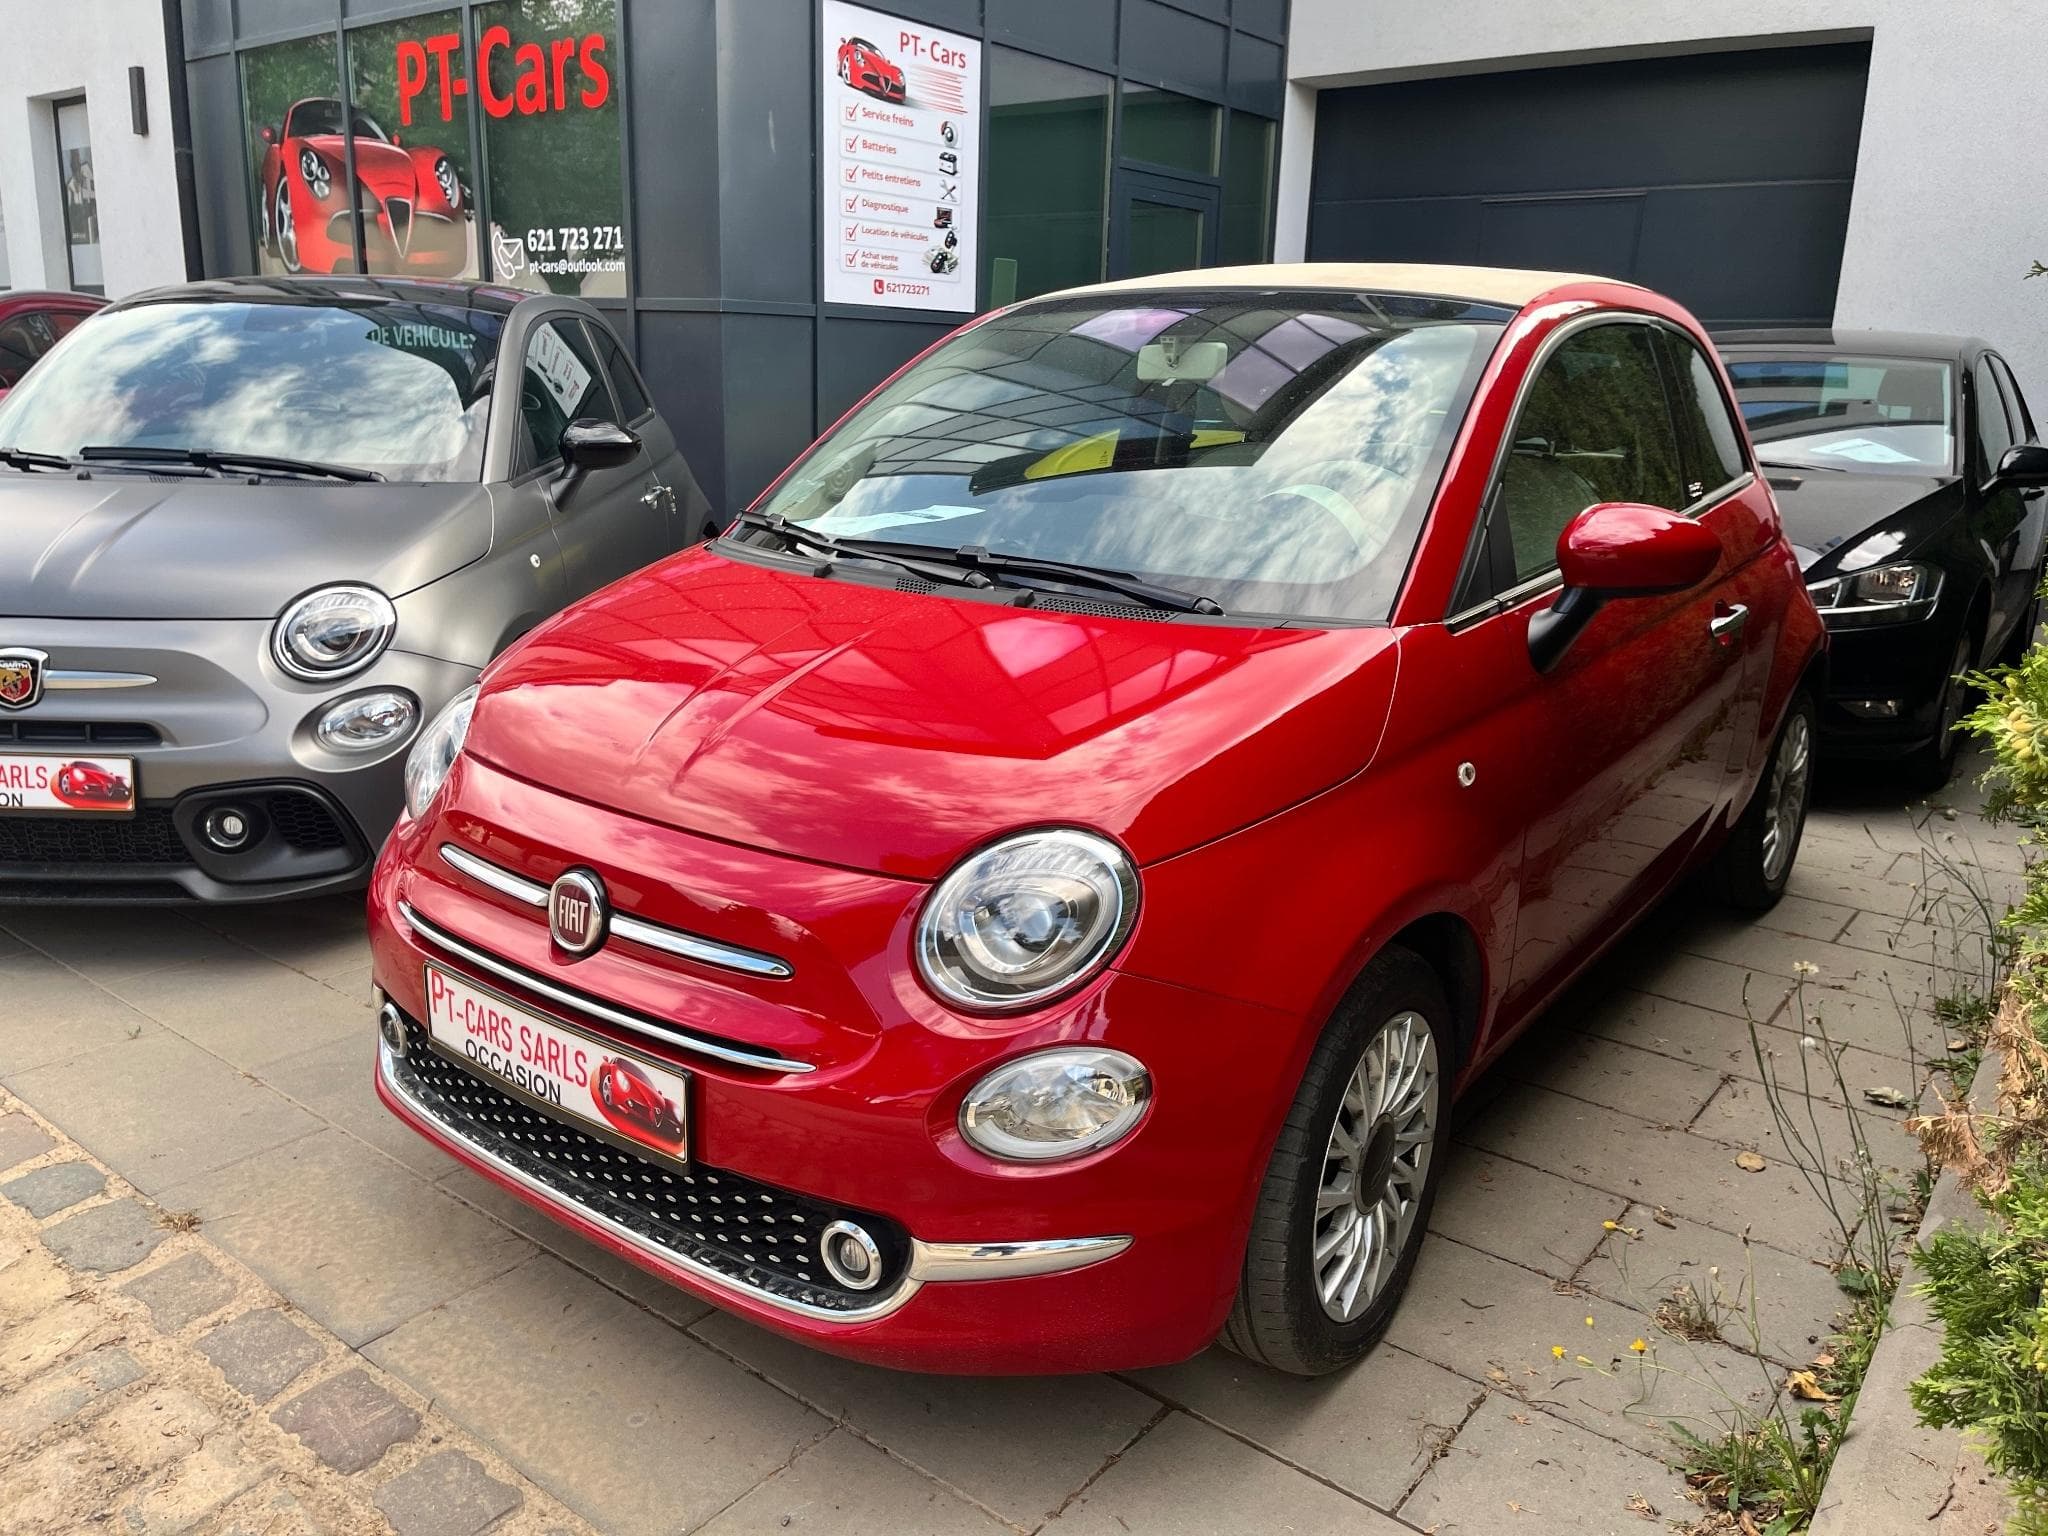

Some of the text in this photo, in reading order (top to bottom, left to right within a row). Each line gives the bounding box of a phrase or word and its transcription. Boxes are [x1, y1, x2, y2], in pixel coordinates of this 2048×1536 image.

[862, 107, 914, 127] Service freins
[862, 139, 897, 154] Batteries
[862, 169, 921, 187] Petits entretiens
[862, 199, 909, 214] Diagnostique
[527, 226, 624, 252] 621 723 271
[861, 226, 890, 236] Location
[890, 229, 899, 238] de
[861, 250, 880, 259] Achat
[529, 258, 625, 276] pt-cars@outlook.com
[861, 260, 869, 268] de
[886, 282, 930, 296] 621723271
[558, 894, 589, 934] FIAT
[431, 969, 588, 1088] PT-CARS SARLS
[465, 1038, 561, 1105] OCCASION
